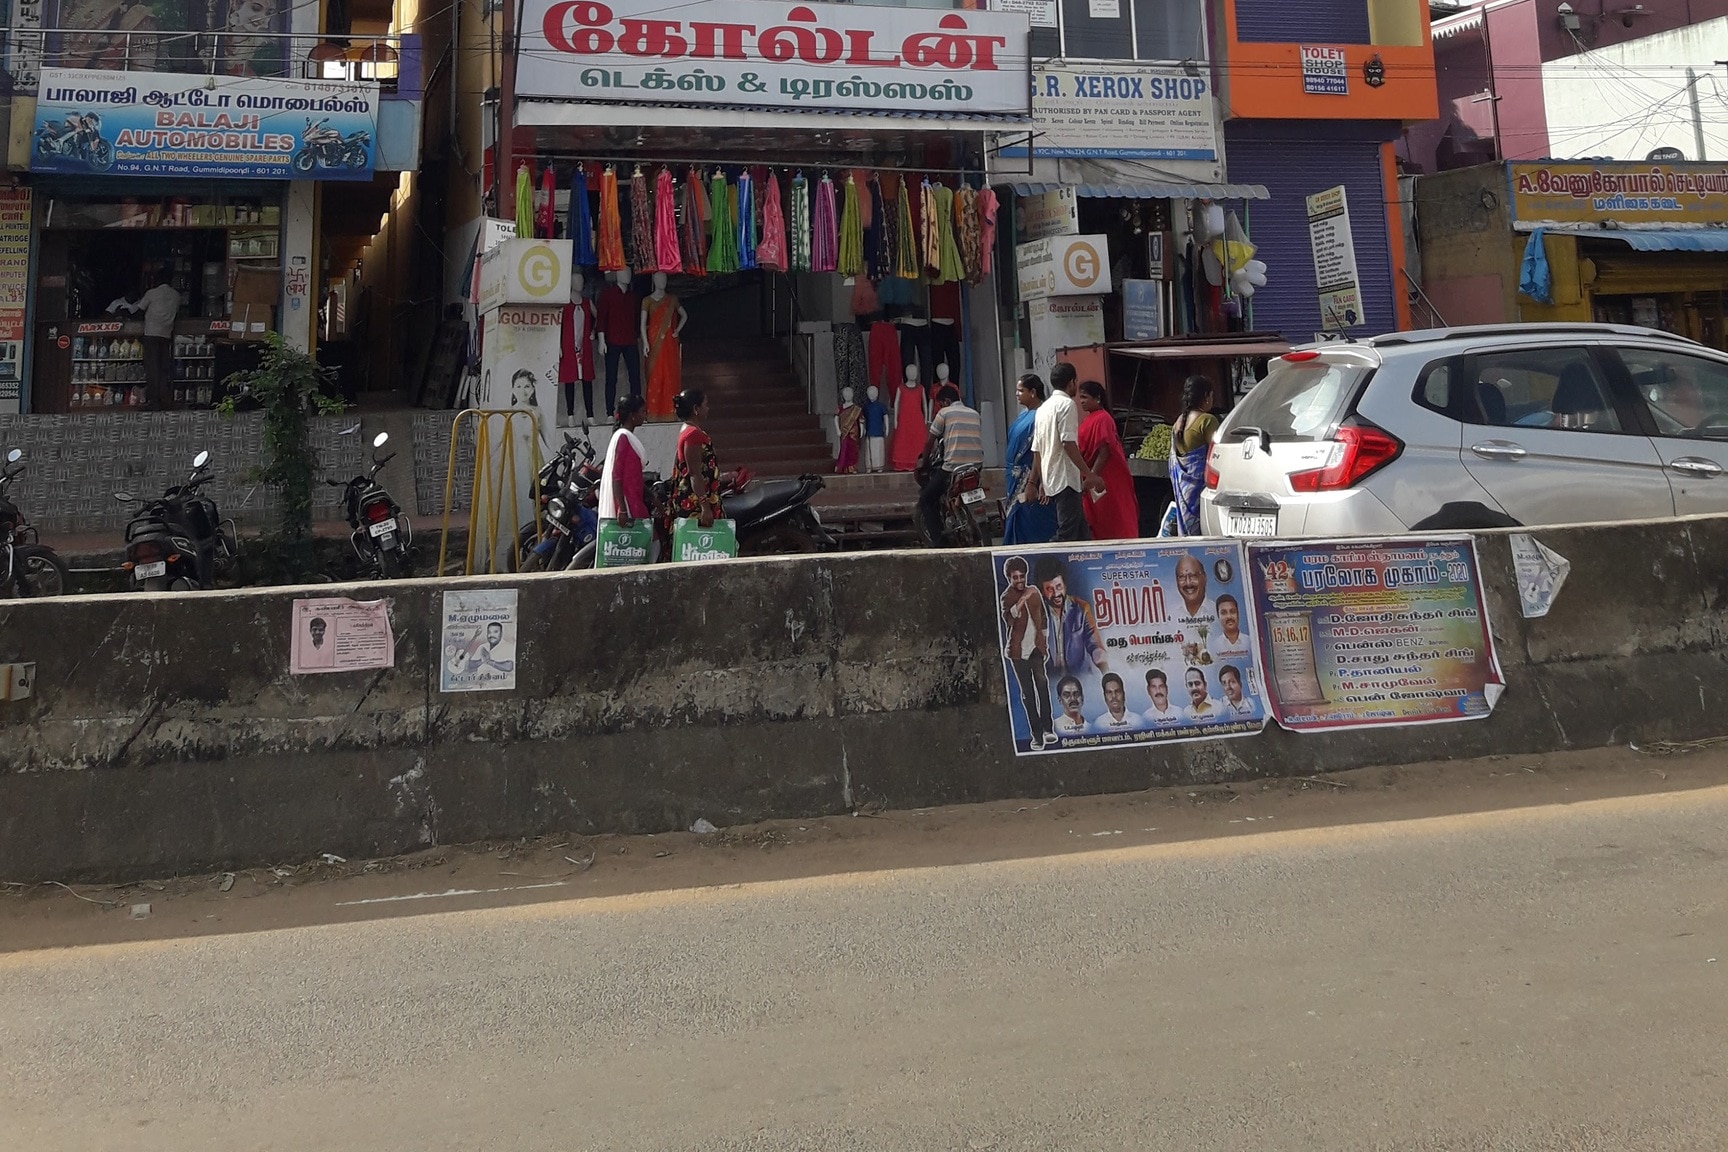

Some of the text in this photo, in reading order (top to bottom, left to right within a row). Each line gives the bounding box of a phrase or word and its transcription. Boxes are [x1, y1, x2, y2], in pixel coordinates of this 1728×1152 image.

[541, 0, 1006, 71] கோல்டன்
[1302, 47, 1345, 60] TOLET
[1305, 58, 1343, 69] SHOP
[1305, 67, 1344, 76] HOUSE
[580, 67, 726, 91] டெக்ஸ்
[737, 73, 767, 92] &
[1074, 75, 1144, 99] XEROX
[1151, 77, 1206, 100] SHOP
[46, 87, 370, 114] பாலாஜி ஆட்டோ மொபைல்ஸ்
[1033, 107, 1081, 115] AUTHORISED
[156, 111, 260, 130] BALAJI
[117, 129, 294, 151] AUTOMOBILES
[160, 153, 175, 161] TWO
[176, 153, 213, 162] WHEELERS
[214, 153, 244, 162] GENUINE
[245, 154, 267, 163] SPARE
[268, 155, 290, 163] PARTS
[117, 164, 142, 172] No.94,
[168, 165, 190, 173] Road,
[192, 166, 250, 175] Gummidipoondi
[500, 311, 560, 326] GOLDEN
[79, 323, 121, 332] MAXXIS
[1102, 571, 1150, 581] SUPER STAR
[1266, 561, 1289, 581] 42
[1302, 565, 1378, 591] பரலோக
[1384, 561, 1438, 588] முகாம்
[1106, 630, 1184, 649] தை பொங்கல்
[1396, 638, 1424, 647] BENZ
